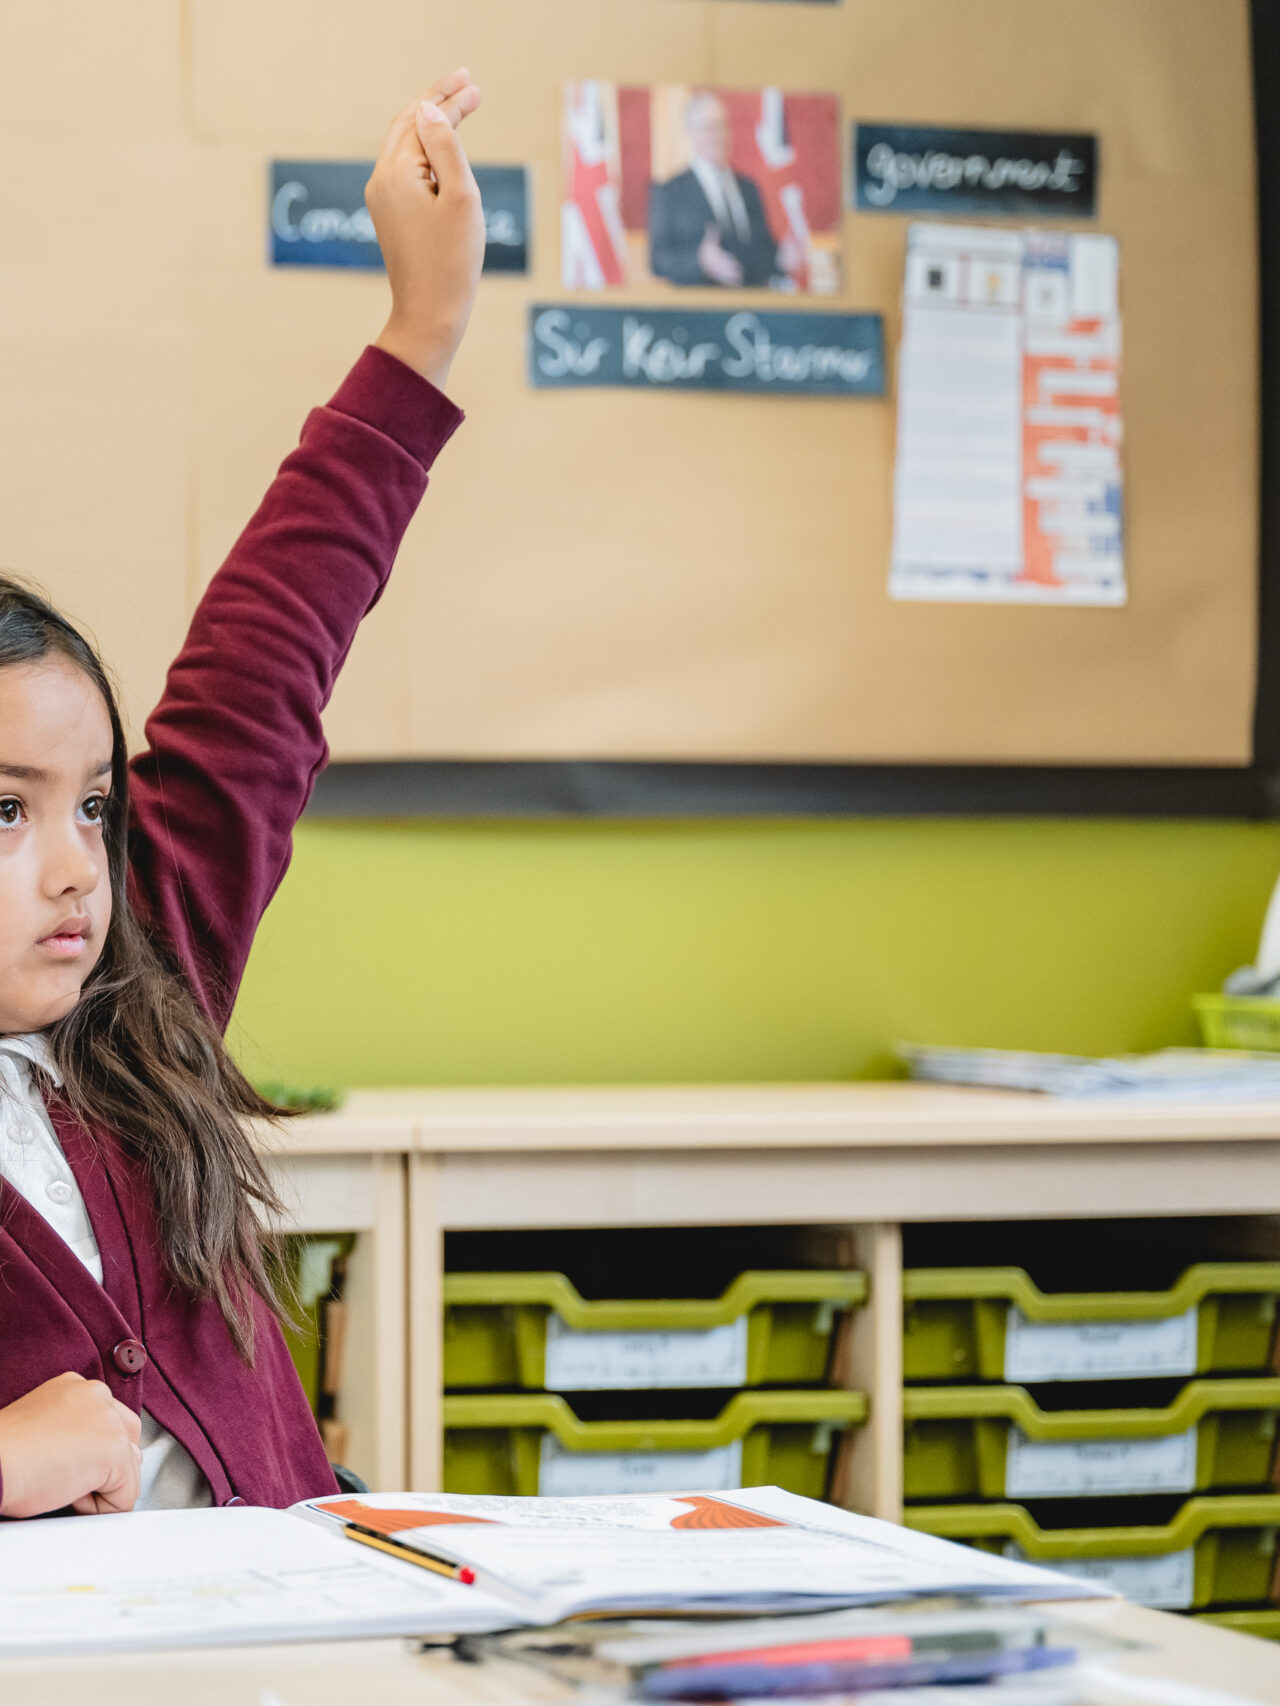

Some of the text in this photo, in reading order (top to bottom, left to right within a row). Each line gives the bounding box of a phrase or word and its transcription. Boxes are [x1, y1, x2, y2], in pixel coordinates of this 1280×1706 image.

[864, 143, 1086, 206] government
[534, 309, 870, 383] Sir Keir Starmer
